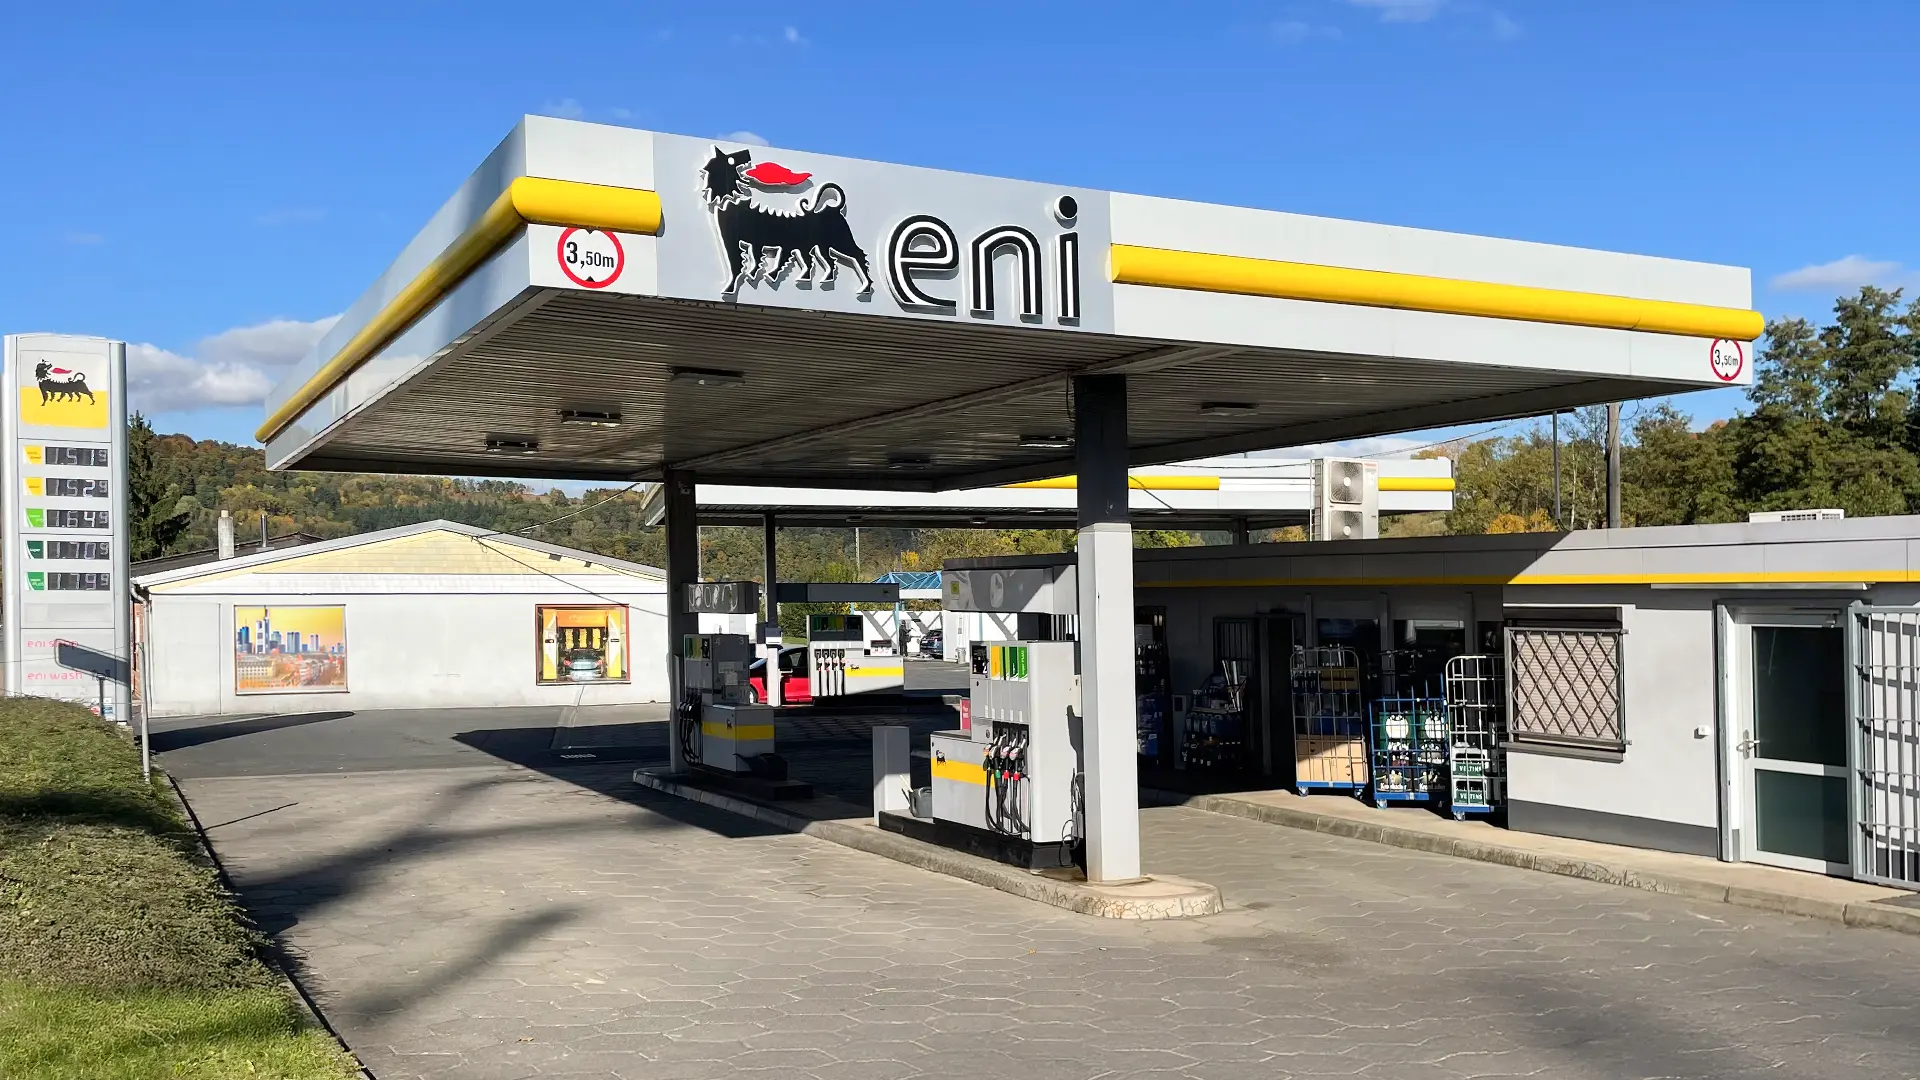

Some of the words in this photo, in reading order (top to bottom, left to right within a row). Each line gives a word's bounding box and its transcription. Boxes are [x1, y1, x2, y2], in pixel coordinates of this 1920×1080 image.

[566, 241, 614, 269] 3,50m
[885, 195, 1080, 318] eni
[1714, 349, 1739, 368] 3,50m
[27, 671, 46, 680] eni
[49, 670, 83, 680] wash
